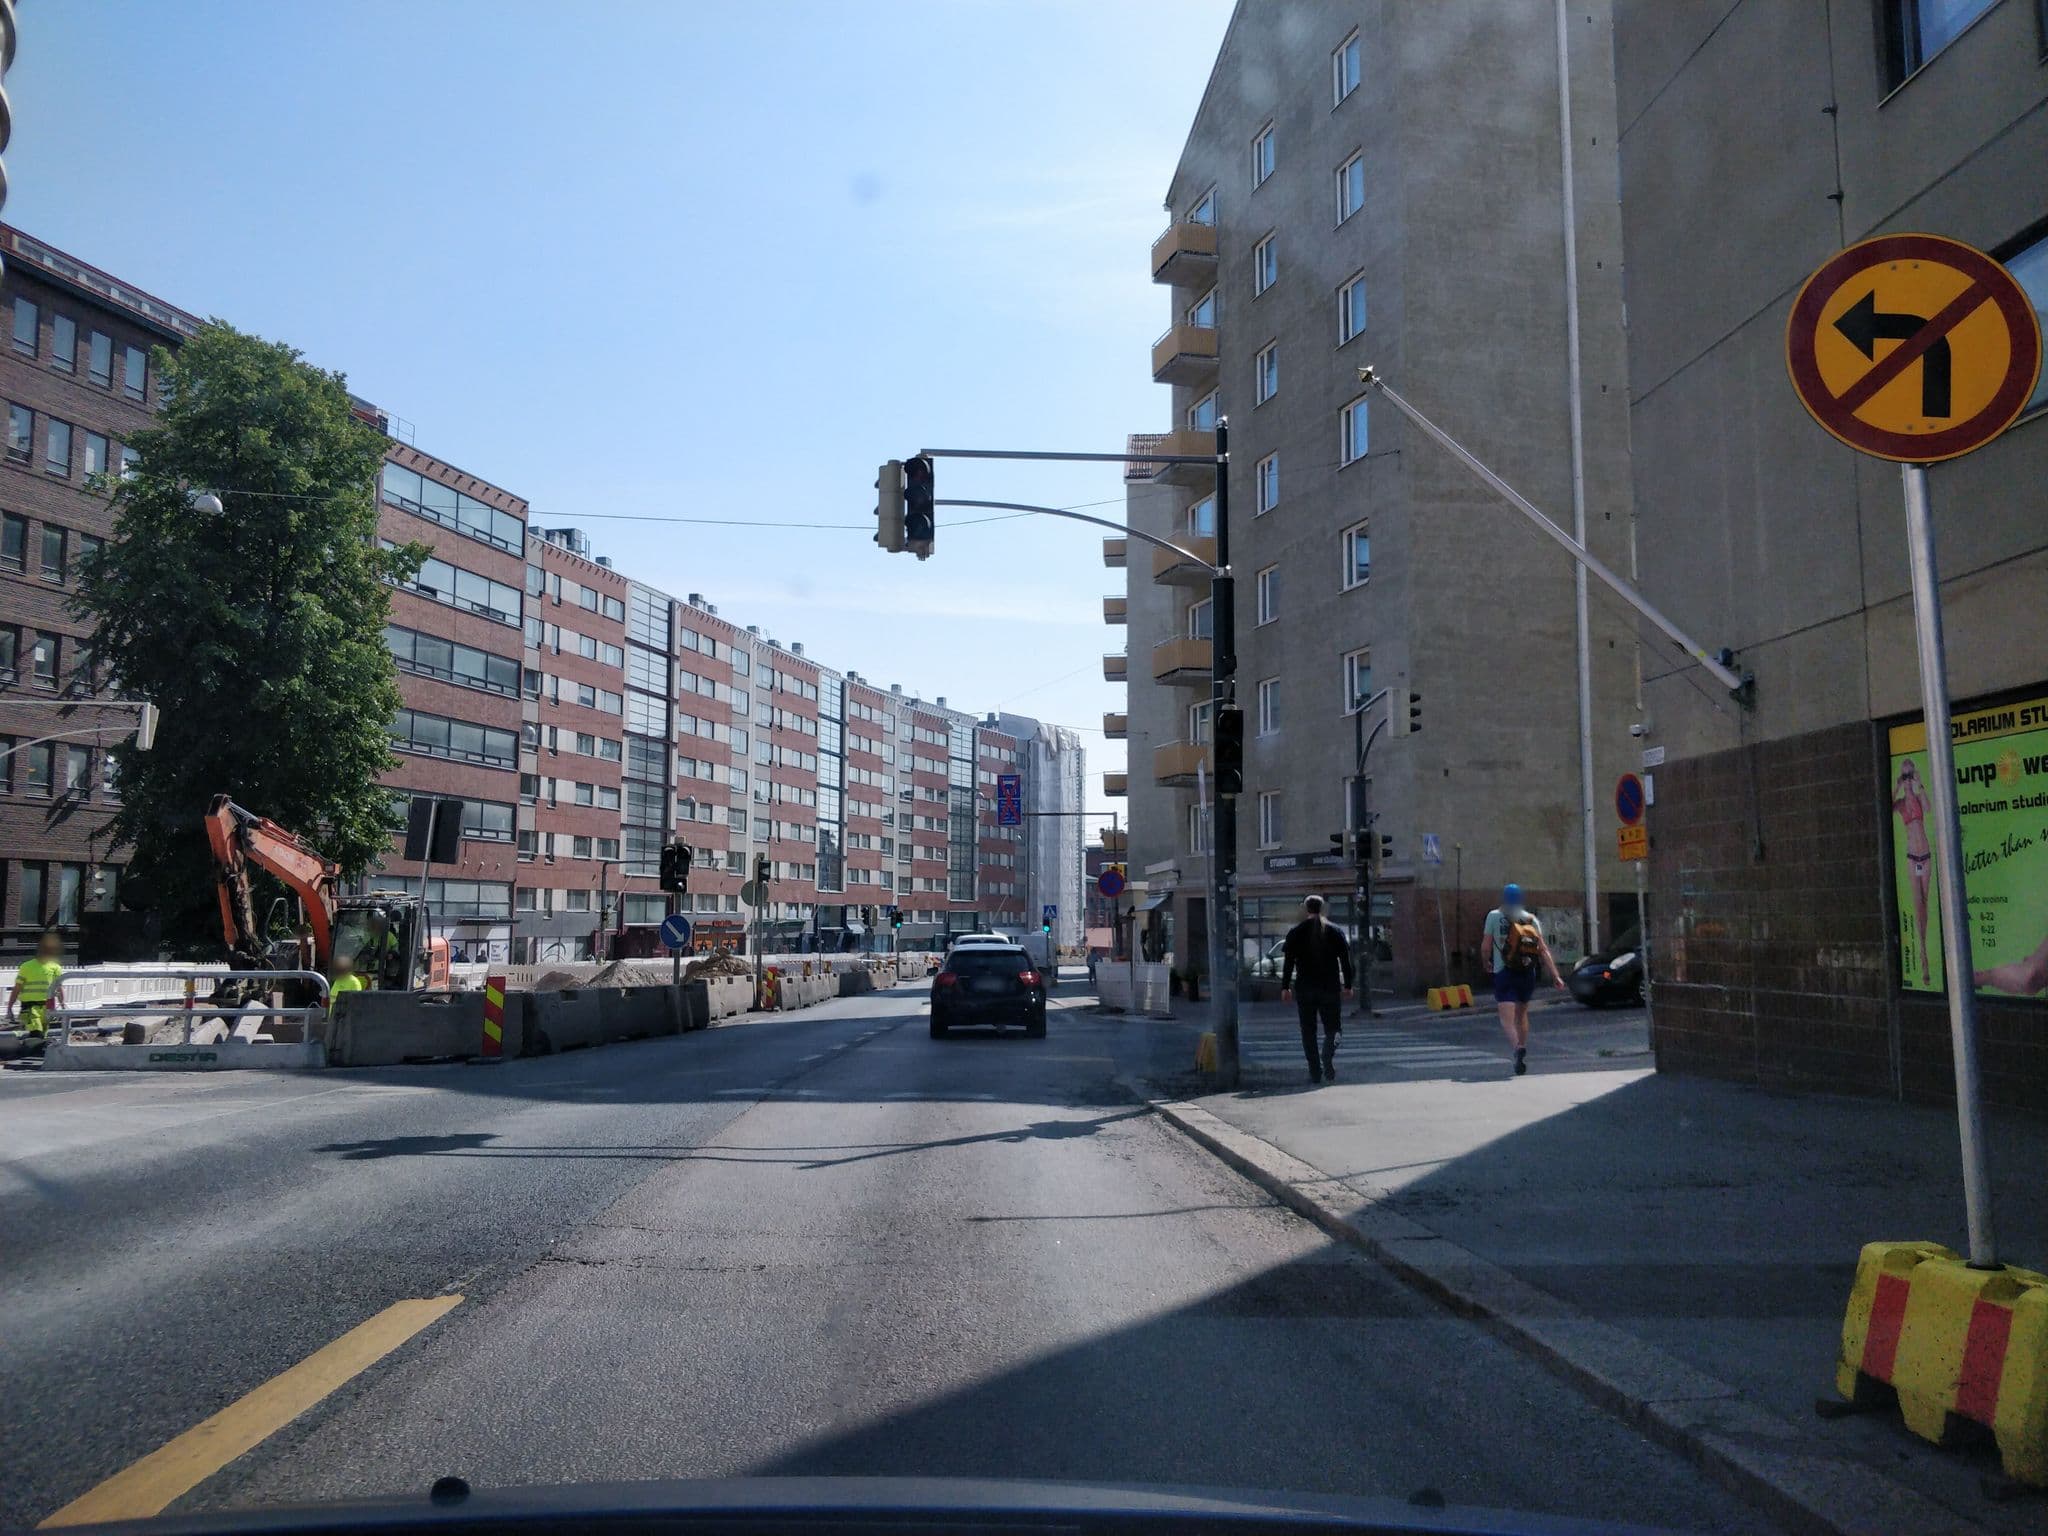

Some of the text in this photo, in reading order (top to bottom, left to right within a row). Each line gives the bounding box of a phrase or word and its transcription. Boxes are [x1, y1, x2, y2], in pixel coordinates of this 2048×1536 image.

[1950, 711, 2015, 738] OLARIUM
[1955, 762, 1996, 788] unp
[1957, 800, 2008, 815] olarium
[2000, 832, 2033, 858] than
